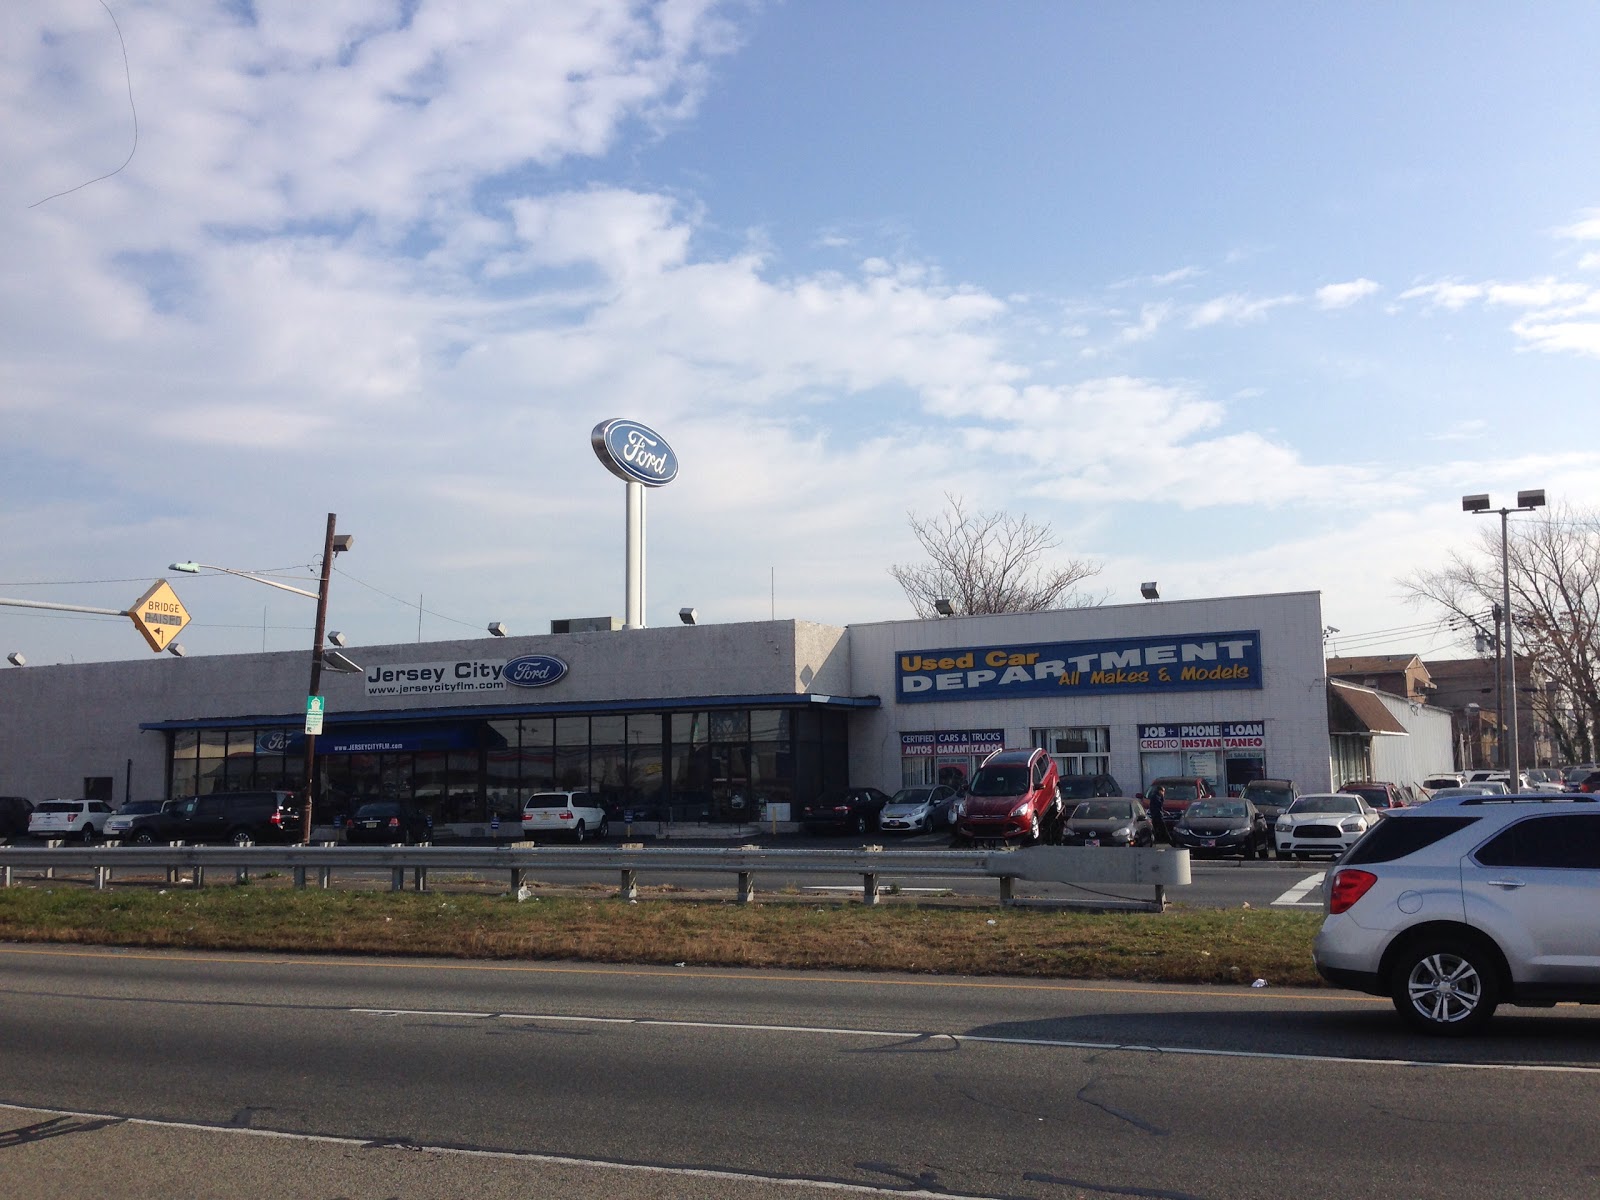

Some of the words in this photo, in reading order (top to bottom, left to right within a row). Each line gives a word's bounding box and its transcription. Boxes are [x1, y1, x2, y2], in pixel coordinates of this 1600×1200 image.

[624, 430, 667, 475] Ford
[148, 600, 180, 613] BRIDGE
[145, 612, 182, 626] RAISED
[901, 653, 974, 672] Used
[985, 651, 1040, 667] Car
[902, 640, 1253, 693] DEPARTMENT
[368, 667, 445, 683] Jersey
[455, 661, 503, 680] City
[513, 662, 550, 681] Ford
[1058, 670, 1080, 686] All
[1090, 667, 1149, 685] Makes
[1158, 667, 1172, 682] &
[1180, 663, 1250, 681] Models
[368, 681, 504, 695] www.jerseycityflm.com
[902, 735, 934, 743] CERTIFIED
[938, 734, 959, 742] CARS
[961, 734, 968, 742] &
[971, 732, 1001, 741] TRUCKS
[1181, 725, 1220, 737] PHONE
[905, 745, 932, 754] AUTOS
[1141, 739, 1179, 749] CREDITO
